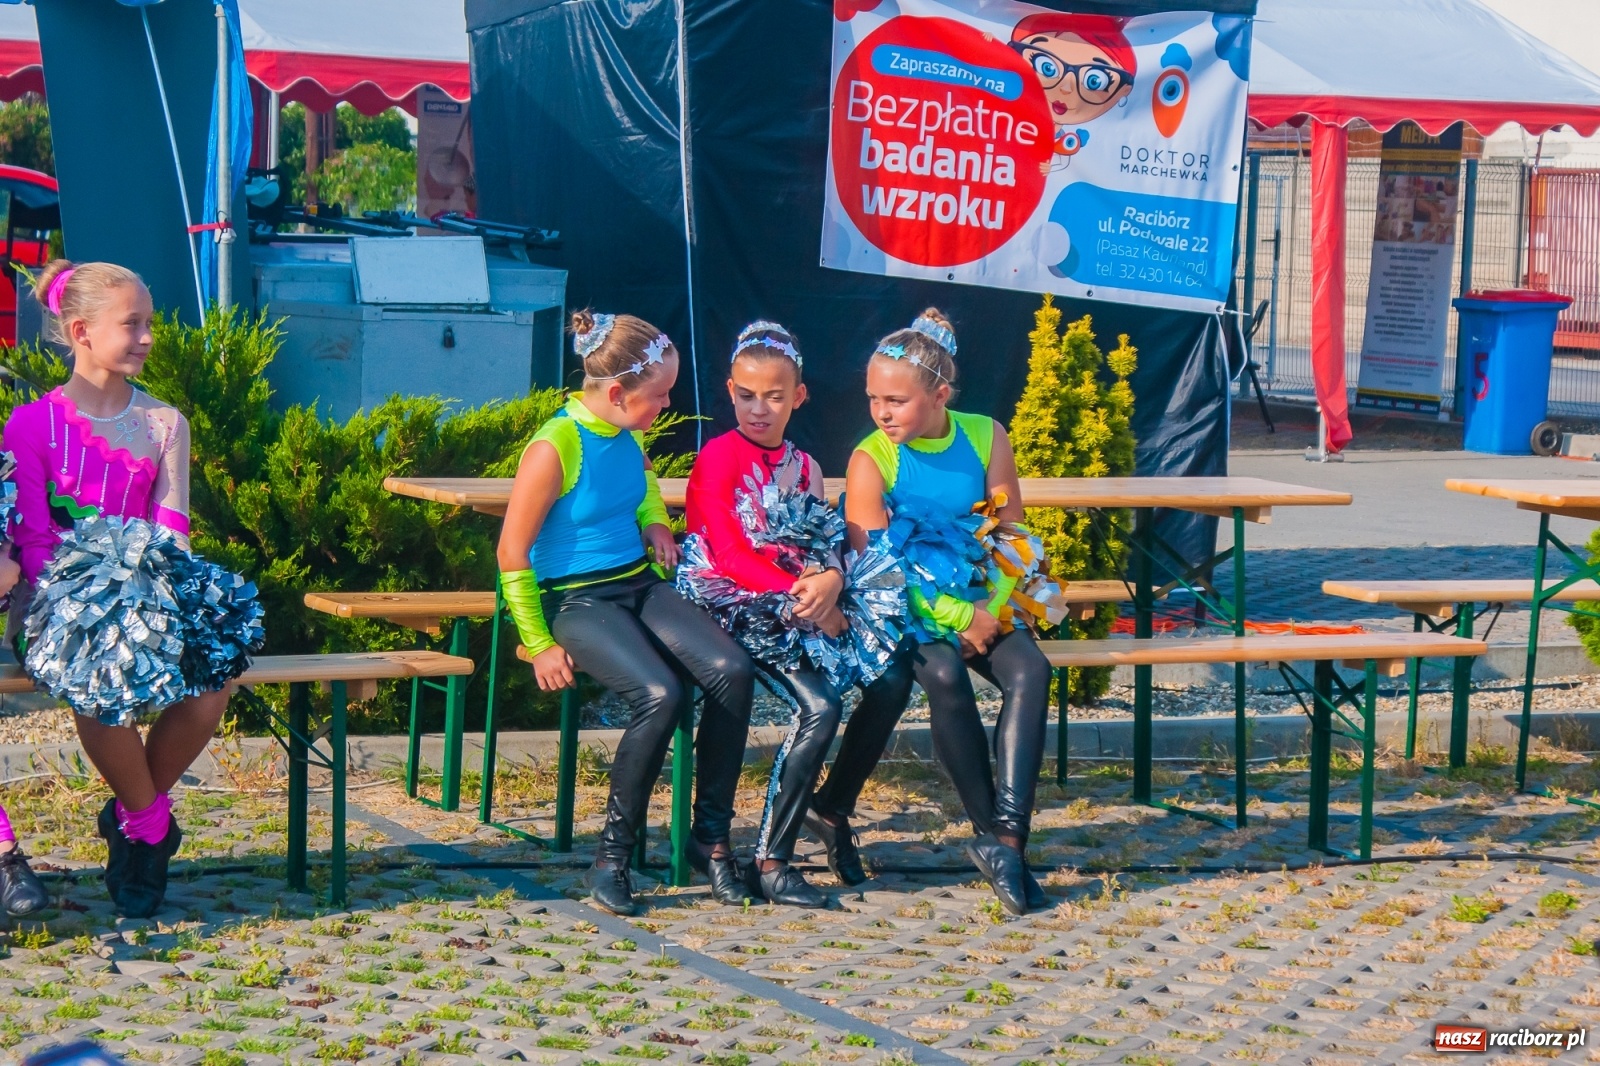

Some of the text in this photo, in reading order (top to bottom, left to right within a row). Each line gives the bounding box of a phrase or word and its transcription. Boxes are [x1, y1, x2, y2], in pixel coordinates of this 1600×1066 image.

[890, 52, 1006, 94] Zapraszamy na
[848, 79, 1039, 146] Bezpłatne
[860, 128, 1016, 187] badania
[1120, 163, 1209, 182] MARCHEWKA
[1121, 146, 1210, 169] DOKTOR
[862, 183, 1005, 230] wzroku
[1124, 206, 1191, 230] Racibórz
[1098, 217, 1209, 253] ul. Podwale 22
[1096, 262, 1115, 277] tel.
[1119, 263, 1136, 280] 32
[1138, 267, 1164, 283] 430
[1167, 270, 1182, 285] 14
[1471, 352, 1491, 402] 5
